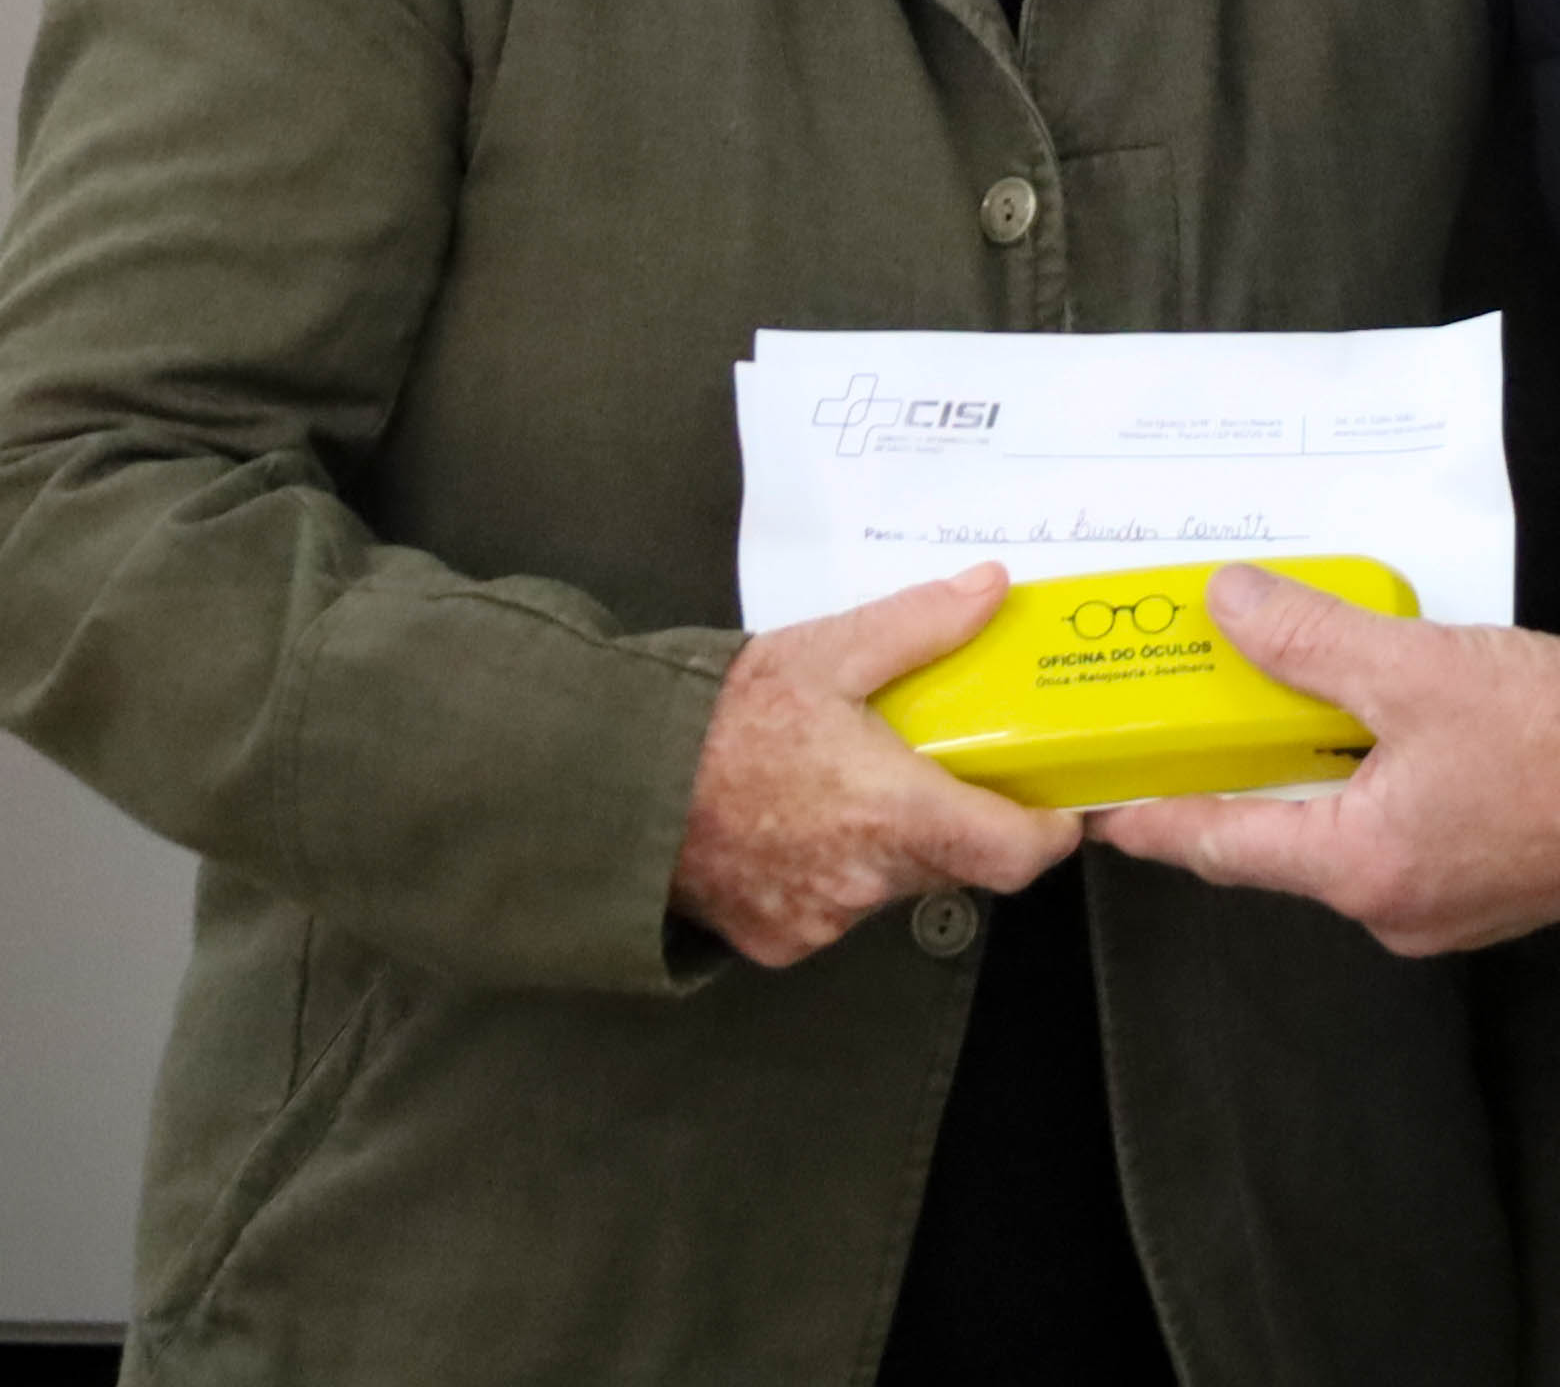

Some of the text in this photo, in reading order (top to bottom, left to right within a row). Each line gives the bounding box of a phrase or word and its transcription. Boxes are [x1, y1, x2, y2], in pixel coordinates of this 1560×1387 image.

[904, 400, 1002, 430] CISI
[1037, 640, 1213, 670] OFICINA DO ÓCULOS
